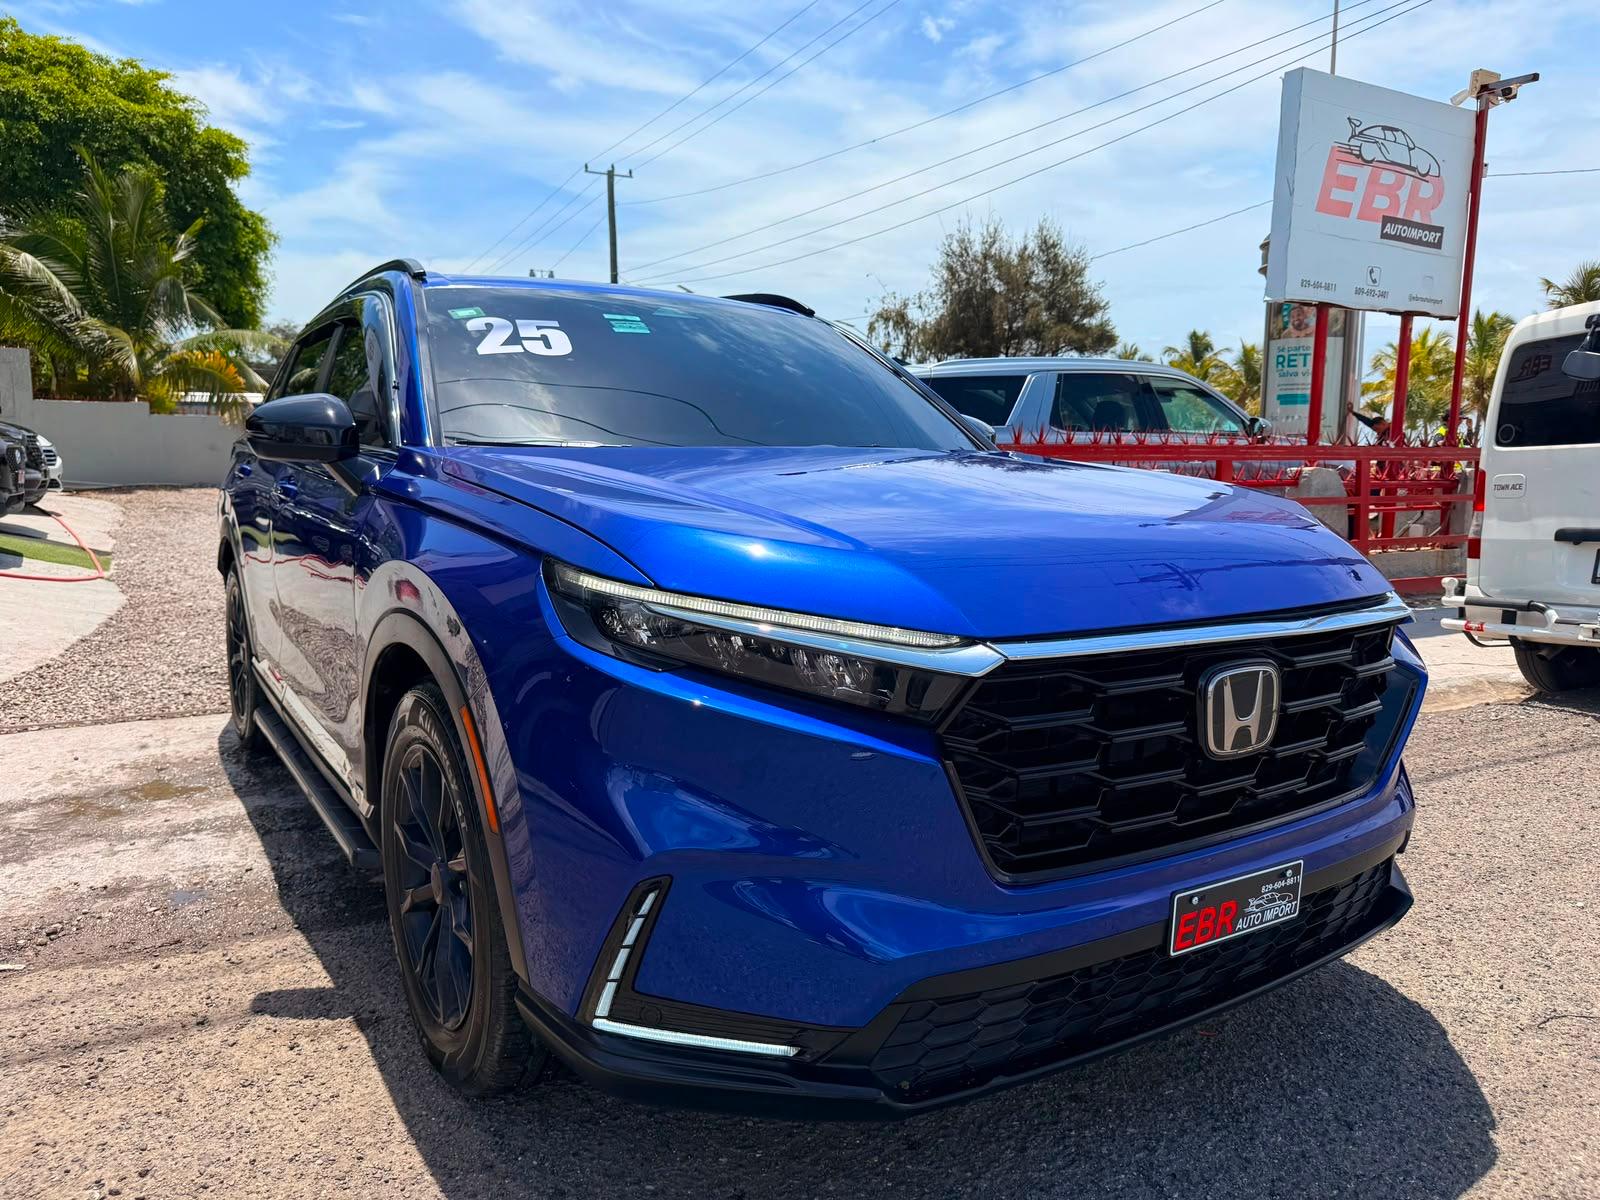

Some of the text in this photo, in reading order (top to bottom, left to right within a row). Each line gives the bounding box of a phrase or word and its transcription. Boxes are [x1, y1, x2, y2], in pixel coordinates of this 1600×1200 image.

[1315, 144, 1445, 224] EBR
[1383, 222, 1442, 244] AUTOIMPORT
[1300, 278, 1337, 292] 829-604-8811
[466, 316, 573, 356] 25
[1276, 353, 1312, 368] RET
[1493, 483, 1510, 491] TOWN
[1261, 875, 1300, 893] 829-604-8811
[1174, 900, 1238, 950] EBR
[1235, 901, 1298, 932] AUTO IMPORT
